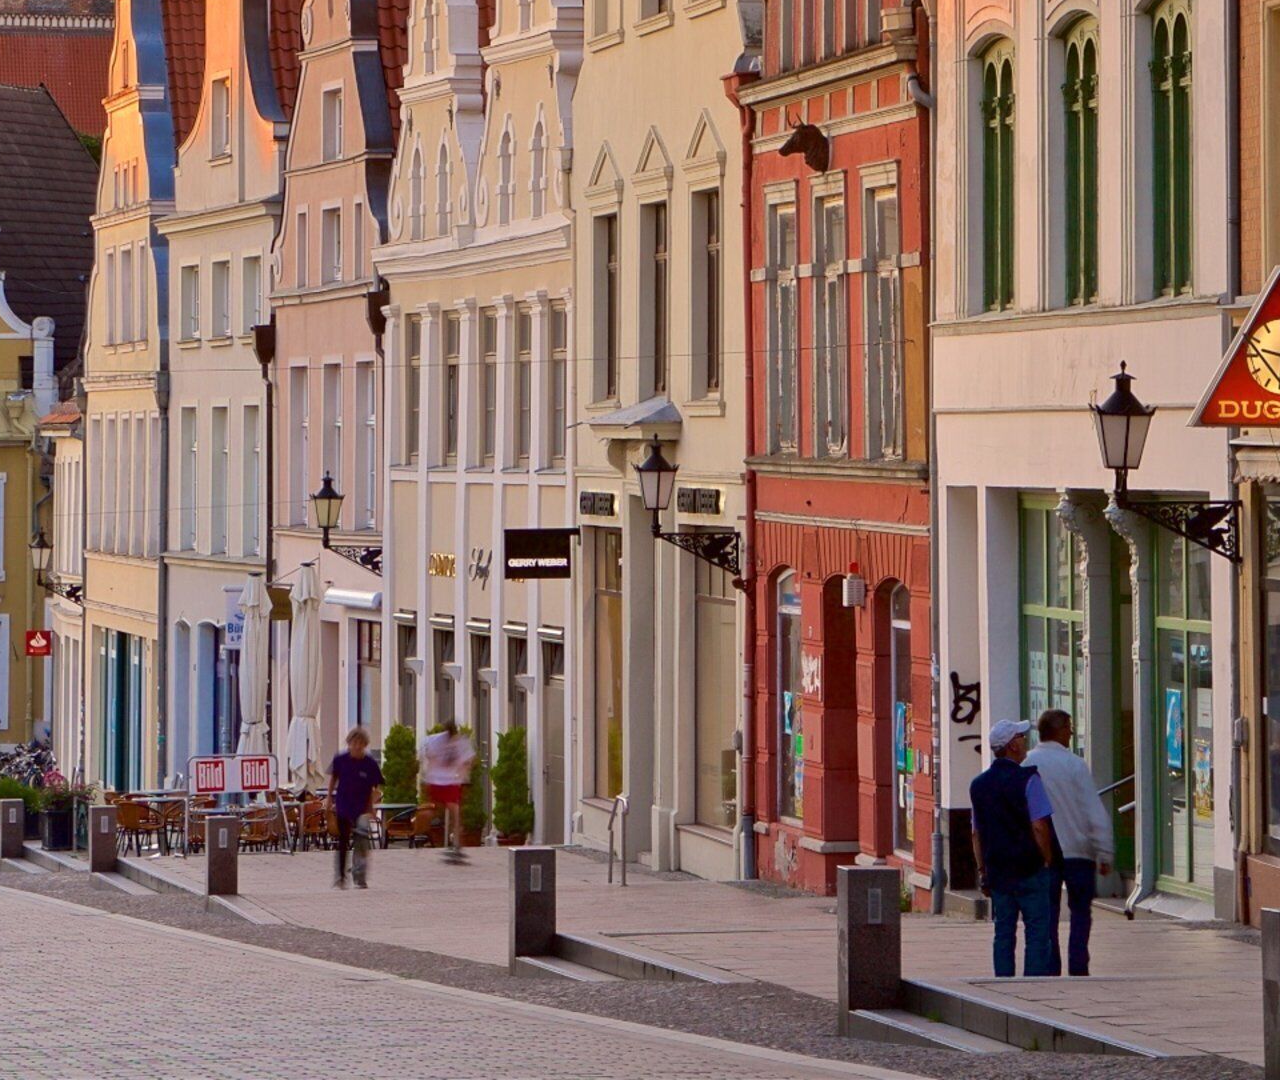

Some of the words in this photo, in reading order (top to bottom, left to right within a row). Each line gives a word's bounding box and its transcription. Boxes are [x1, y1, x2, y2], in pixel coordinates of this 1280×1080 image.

[508, 558, 537, 567] GERRY
[538, 558, 567, 567] WEBER
[198, 762, 222, 788] Bild
[243, 760, 268, 786] Bild
